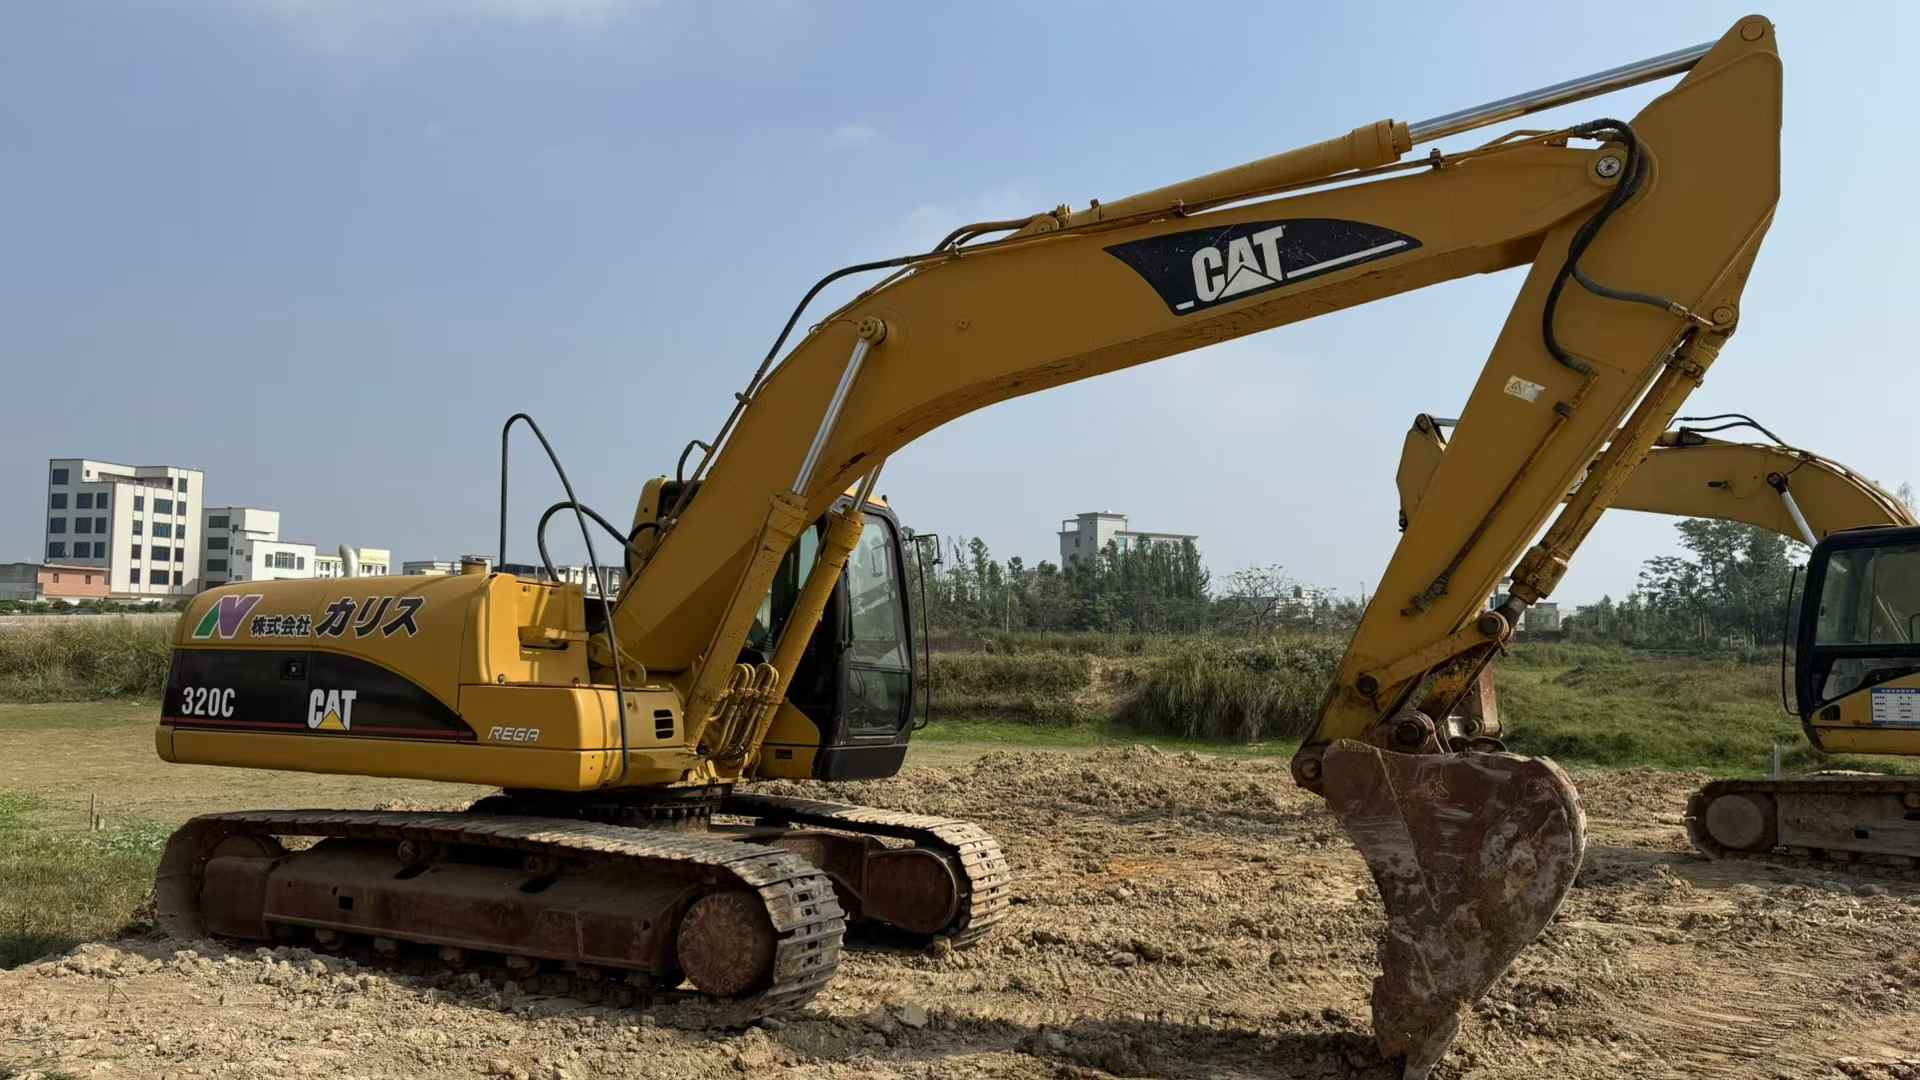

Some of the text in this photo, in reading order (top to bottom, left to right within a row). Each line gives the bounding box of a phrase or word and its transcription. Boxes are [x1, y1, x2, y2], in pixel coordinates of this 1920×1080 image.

[1191, 224, 1285, 302] CAT
[251, 596, 424, 639] 株式会社 カリス
[181, 686, 236, 718] 320C
[307, 688, 357, 731] CAT
[487, 726, 540, 742] REGA
